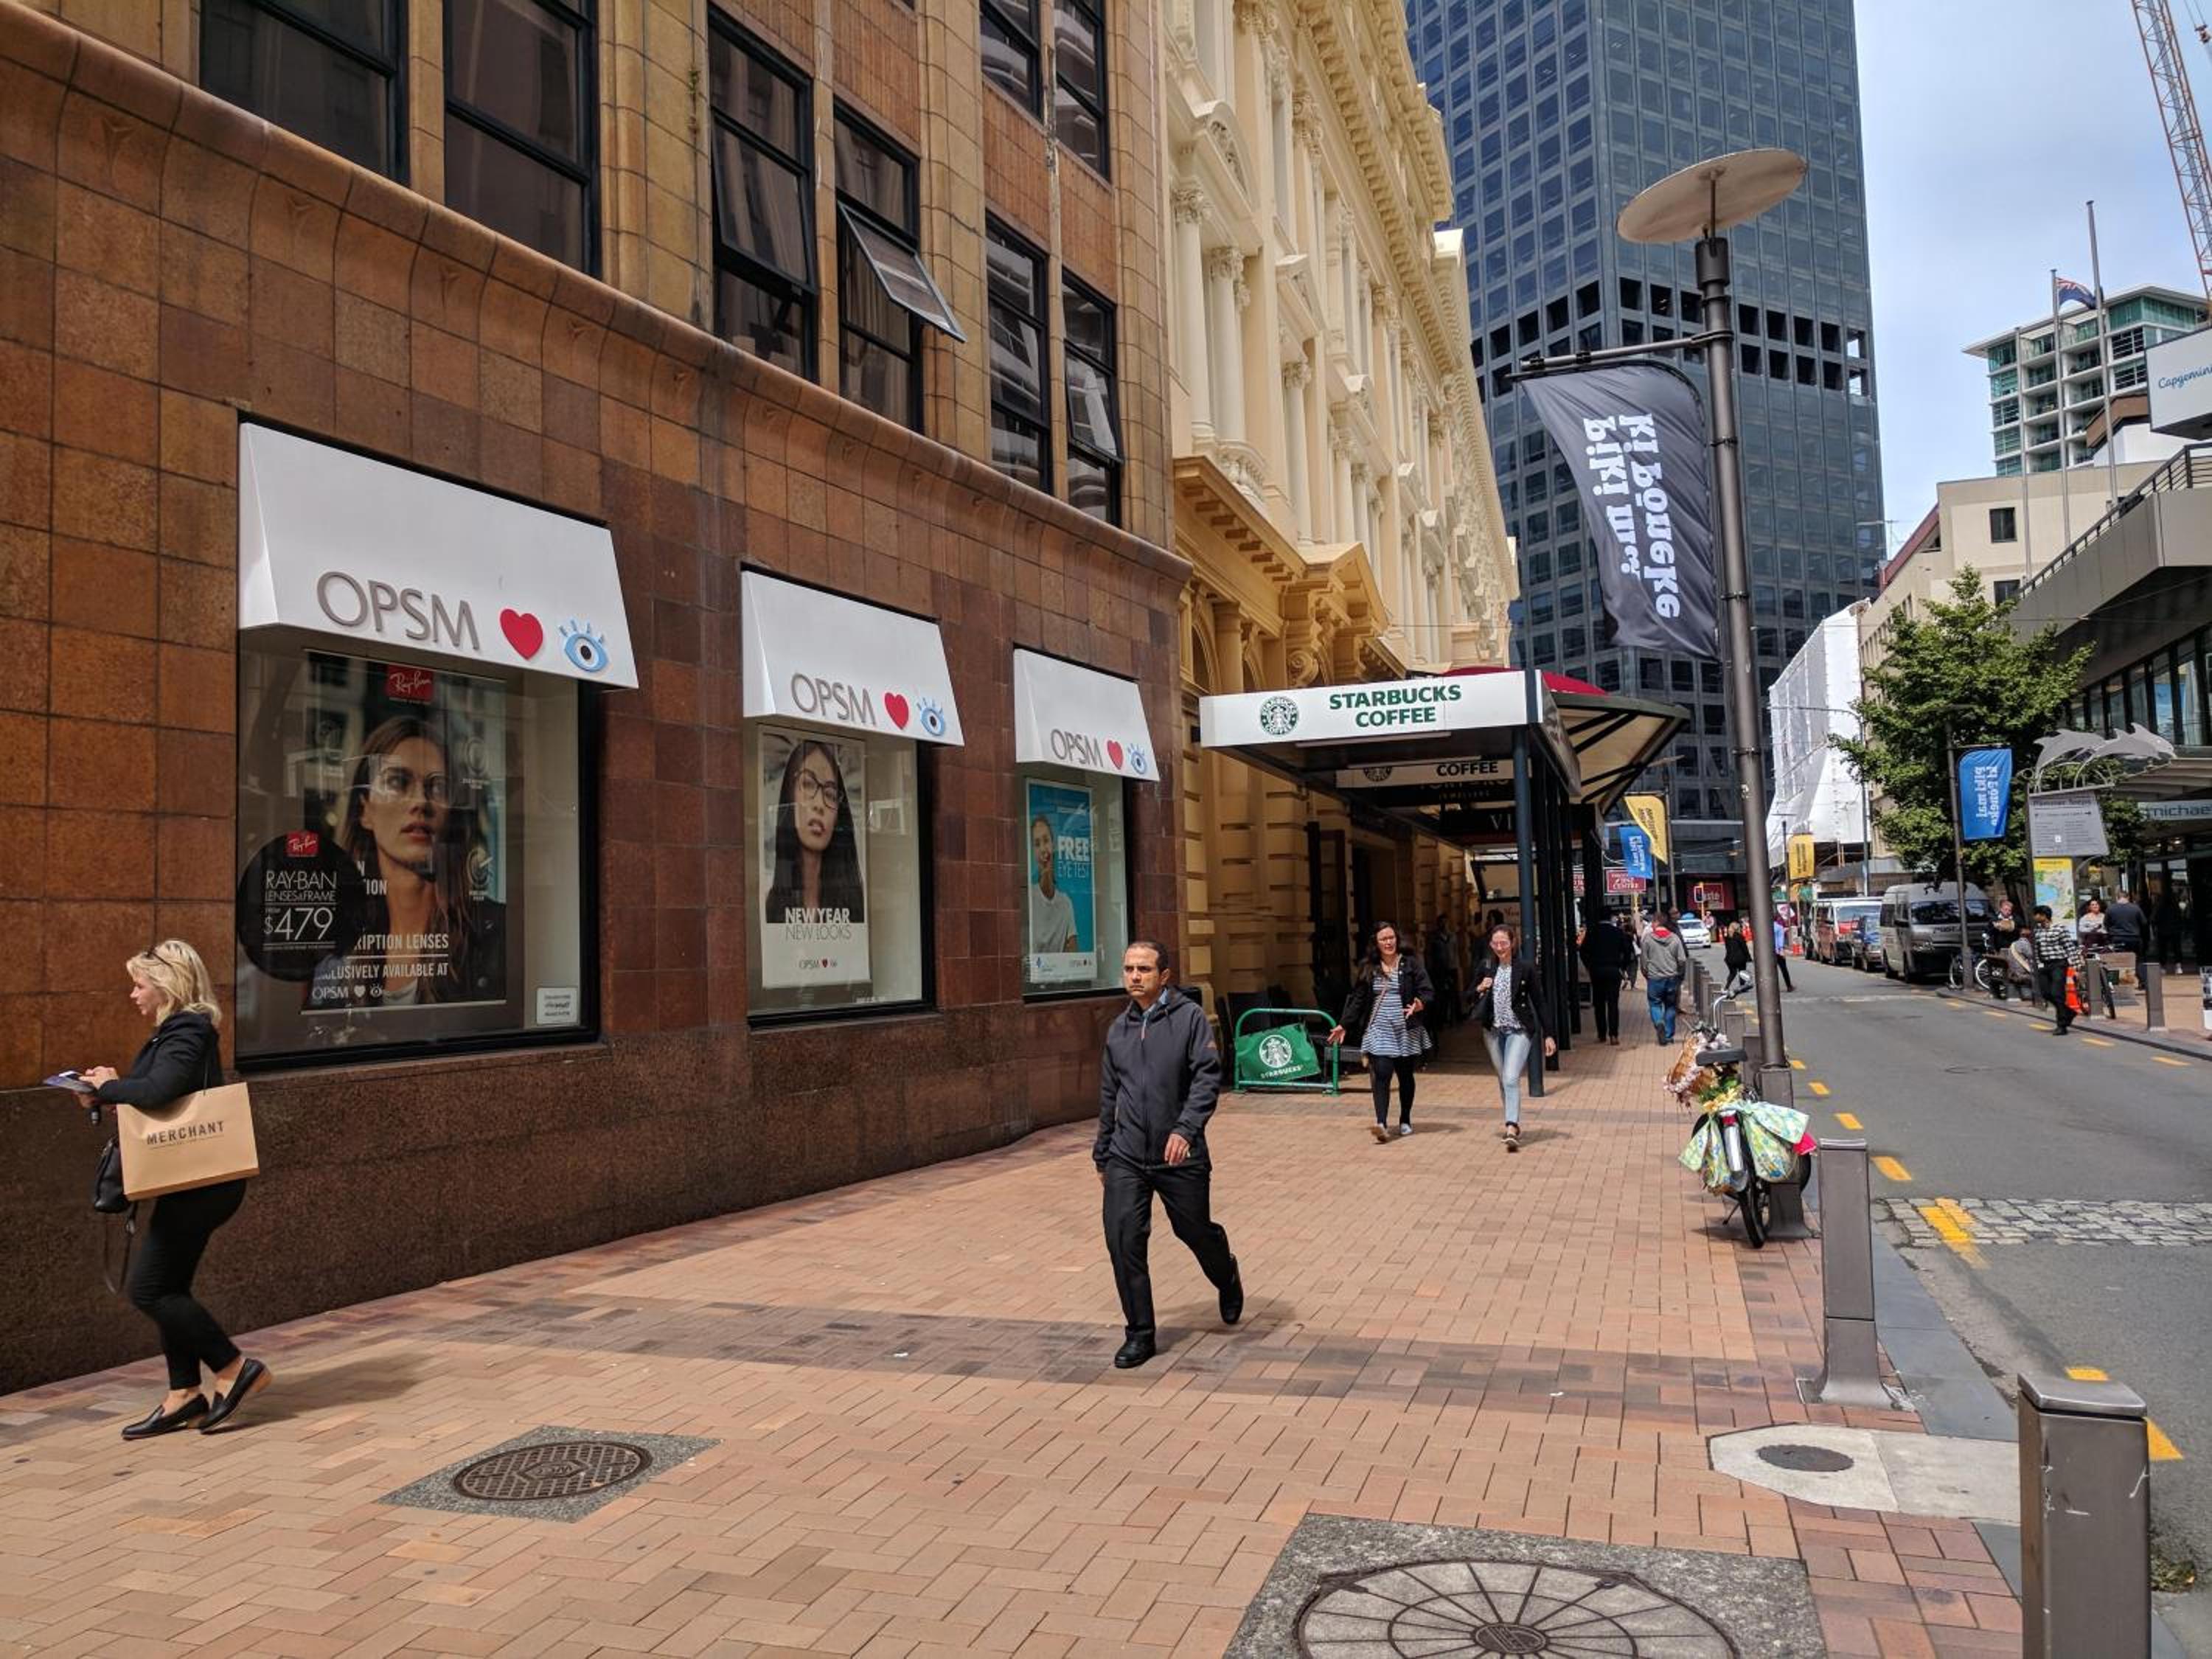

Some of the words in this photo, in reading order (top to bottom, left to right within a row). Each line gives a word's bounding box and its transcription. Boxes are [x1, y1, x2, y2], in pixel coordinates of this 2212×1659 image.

[316, 571, 480, 650] OPSM
[791, 672, 877, 726] OPSM
[1329, 684, 1461, 709] STARBUCKS
[1355, 707, 1436, 727] COFFEE
[1051, 728, 1103, 768] OPSM
[1436, 762, 1499, 776] COFFEE
[1057, 835, 1090, 861] FREE
[265, 870, 337, 890] RAY-BAN
[785, 907, 815, 923] NEW
[817, 908, 851, 924] YEAR
[406, 933, 449, 949] LENSES
[785, 924, 814, 940] NEW
[815, 924, 852, 940] LOOKS
[383, 963, 434, 978] AVAILABLE
[437, 962, 449, 976] AT
[312, 985, 349, 1000] OPSM
[147, 1120, 224, 1144] MERCHANT
